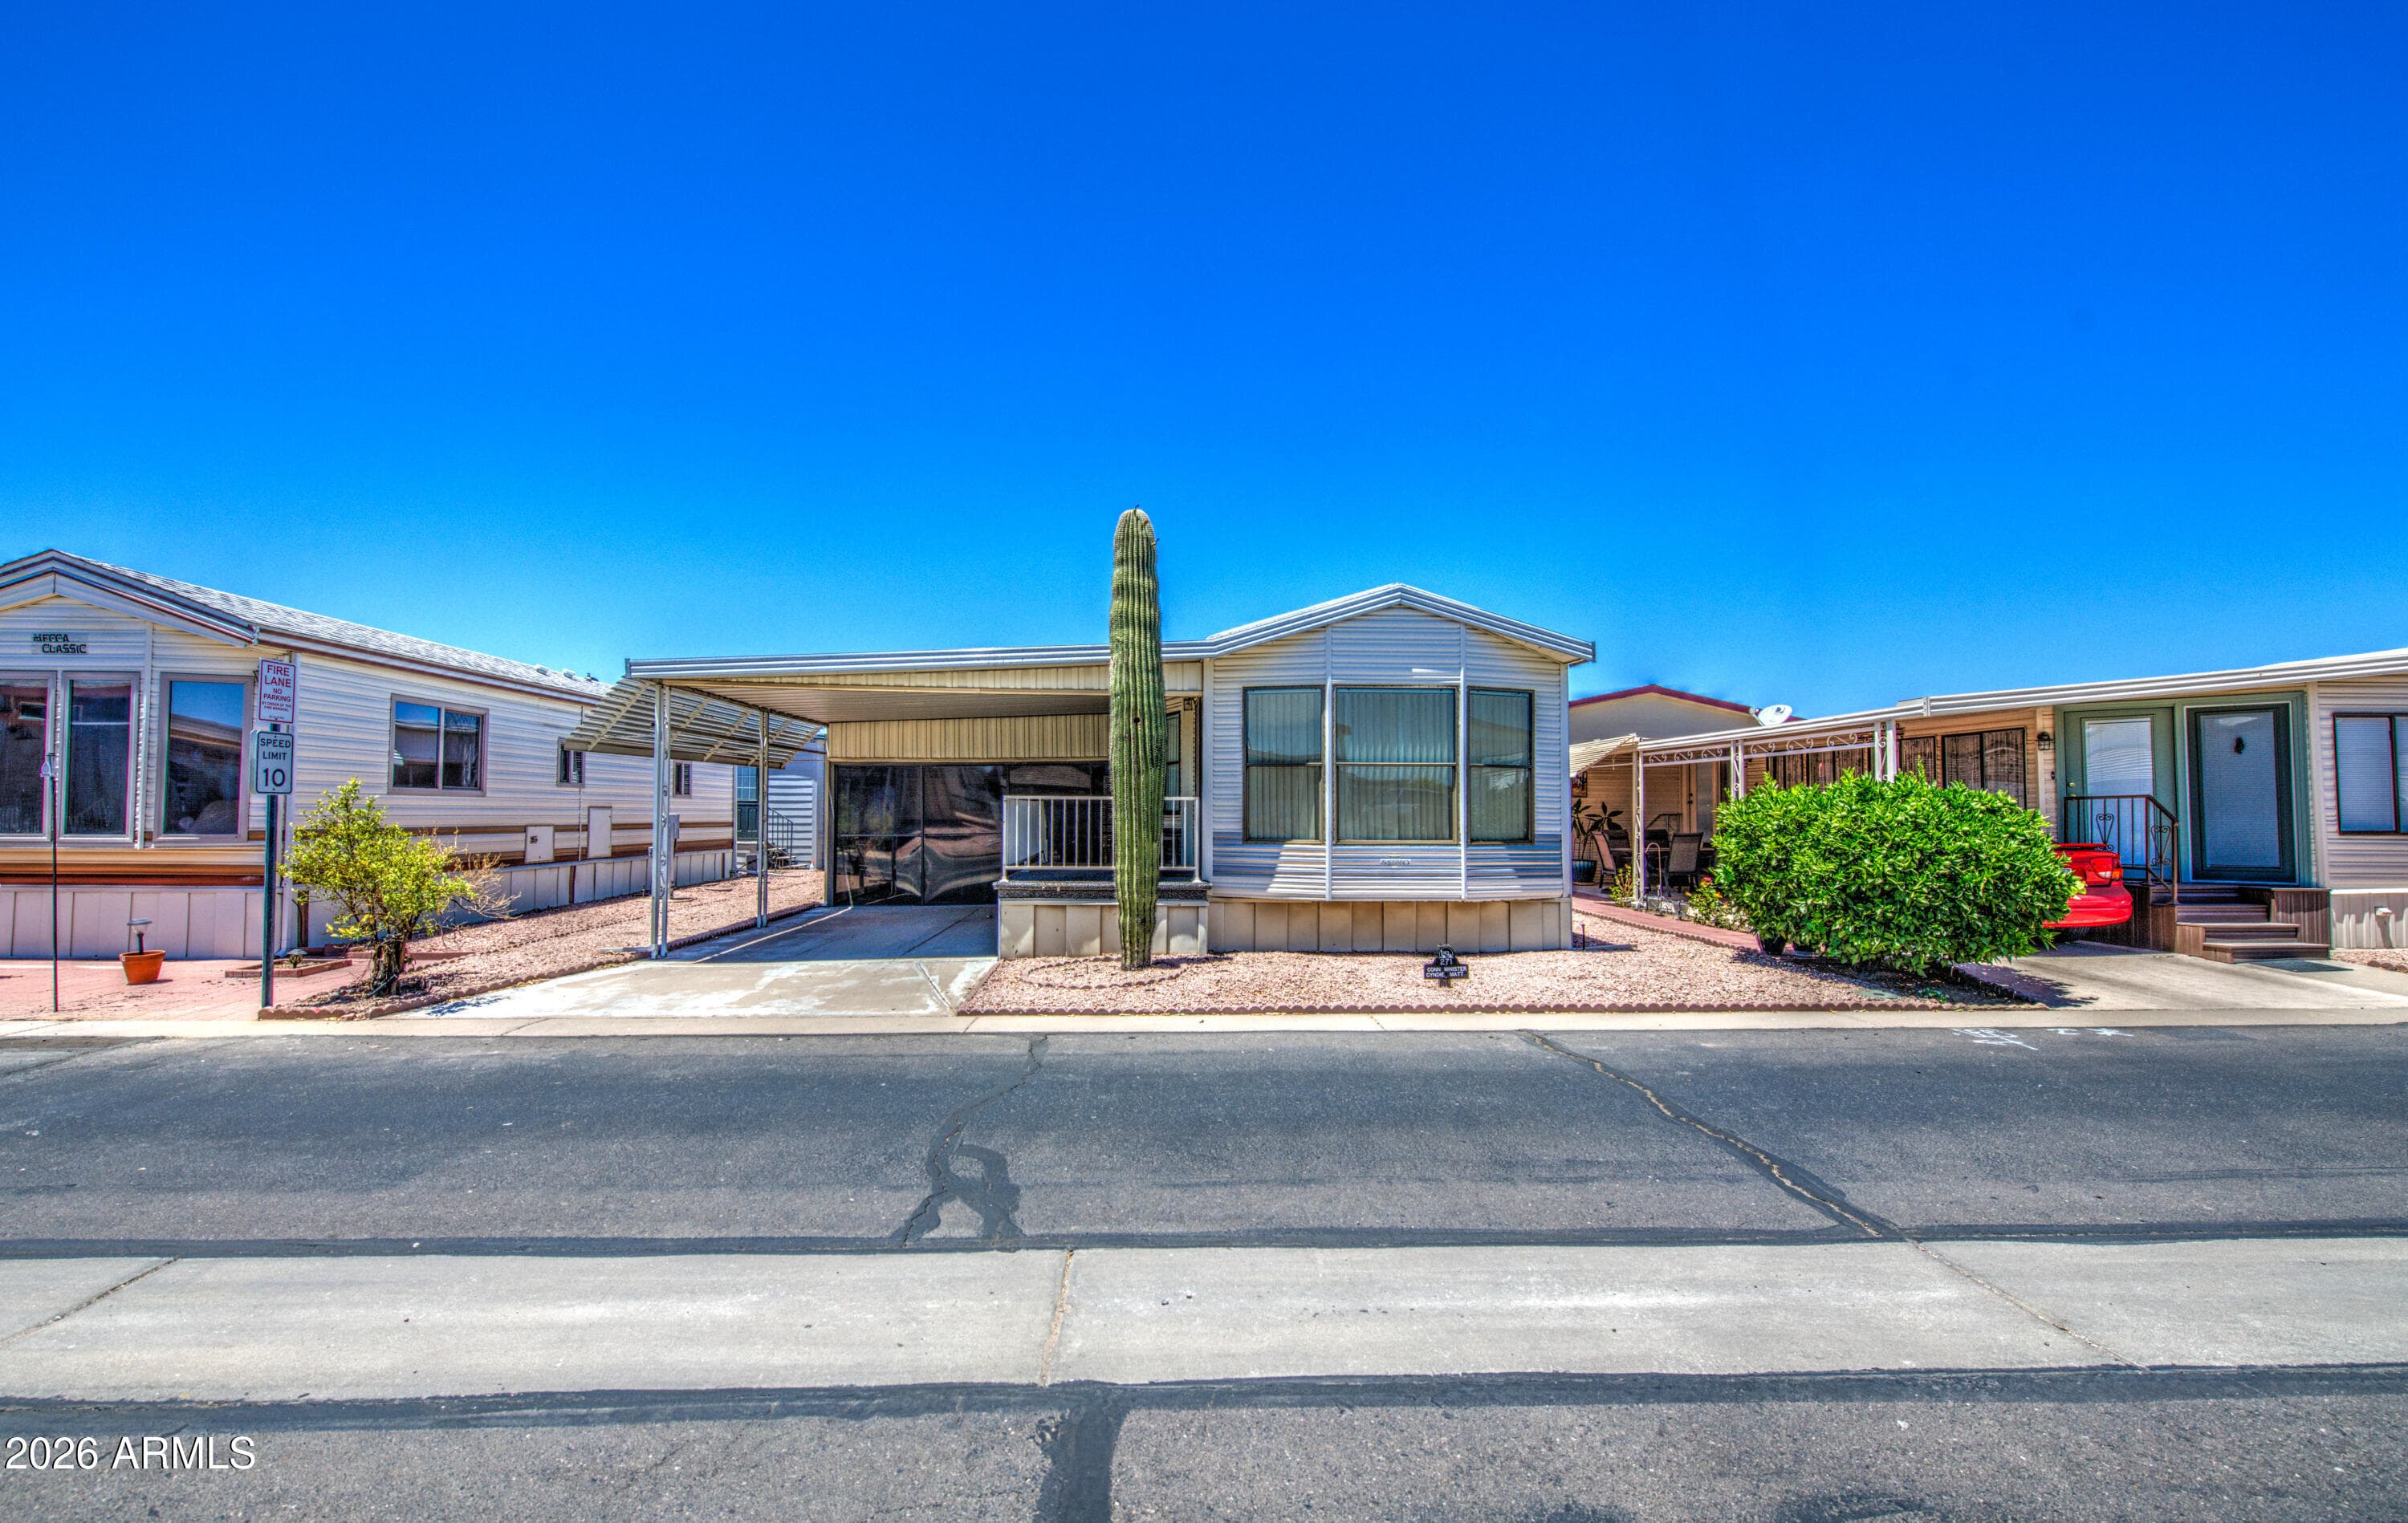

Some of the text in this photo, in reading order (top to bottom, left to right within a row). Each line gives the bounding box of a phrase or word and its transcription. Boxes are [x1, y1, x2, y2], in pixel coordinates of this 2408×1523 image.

[43, 644, 87, 653] CLASSIC
[267, 664, 290, 676] FIRE
[264, 675, 291, 688] LANE
[263, 693, 291, 702] PARKING
[260, 738, 291, 748] SPEED
[262, 751, 287, 761] LIMIT
[263, 768, 286, 787] 10
